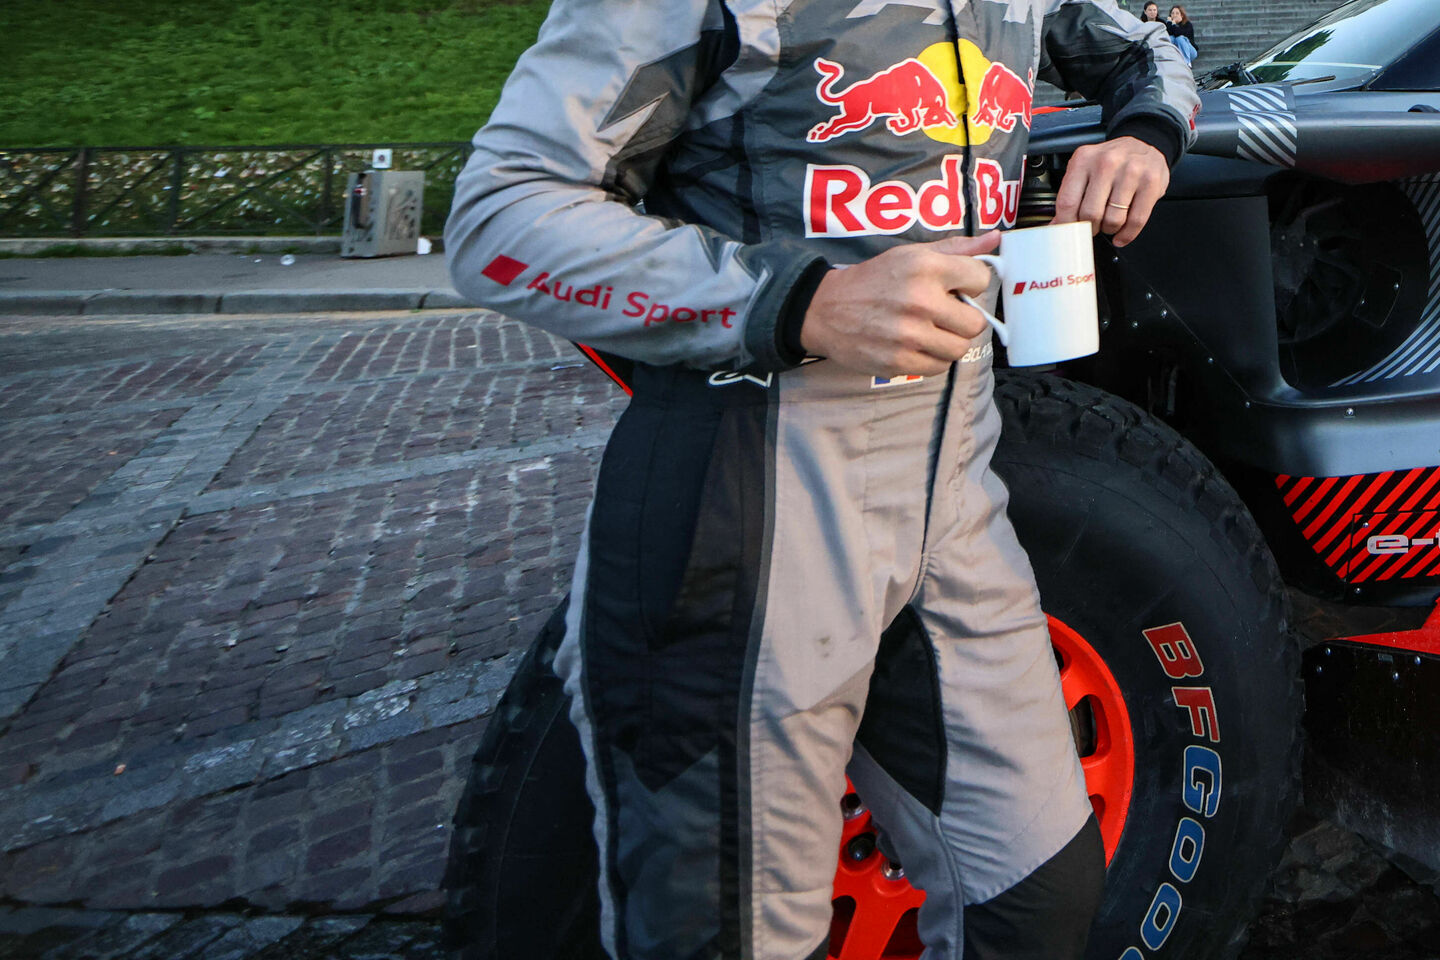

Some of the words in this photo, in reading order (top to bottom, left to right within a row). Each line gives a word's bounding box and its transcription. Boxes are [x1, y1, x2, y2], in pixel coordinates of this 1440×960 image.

[803, 154, 965, 238] Red
[972, 154, 1028, 230] Bu
[527, 271, 614, 311] Audi
[622, 291, 737, 329] Sport
[1028, 276, 1063, 291] Audi
